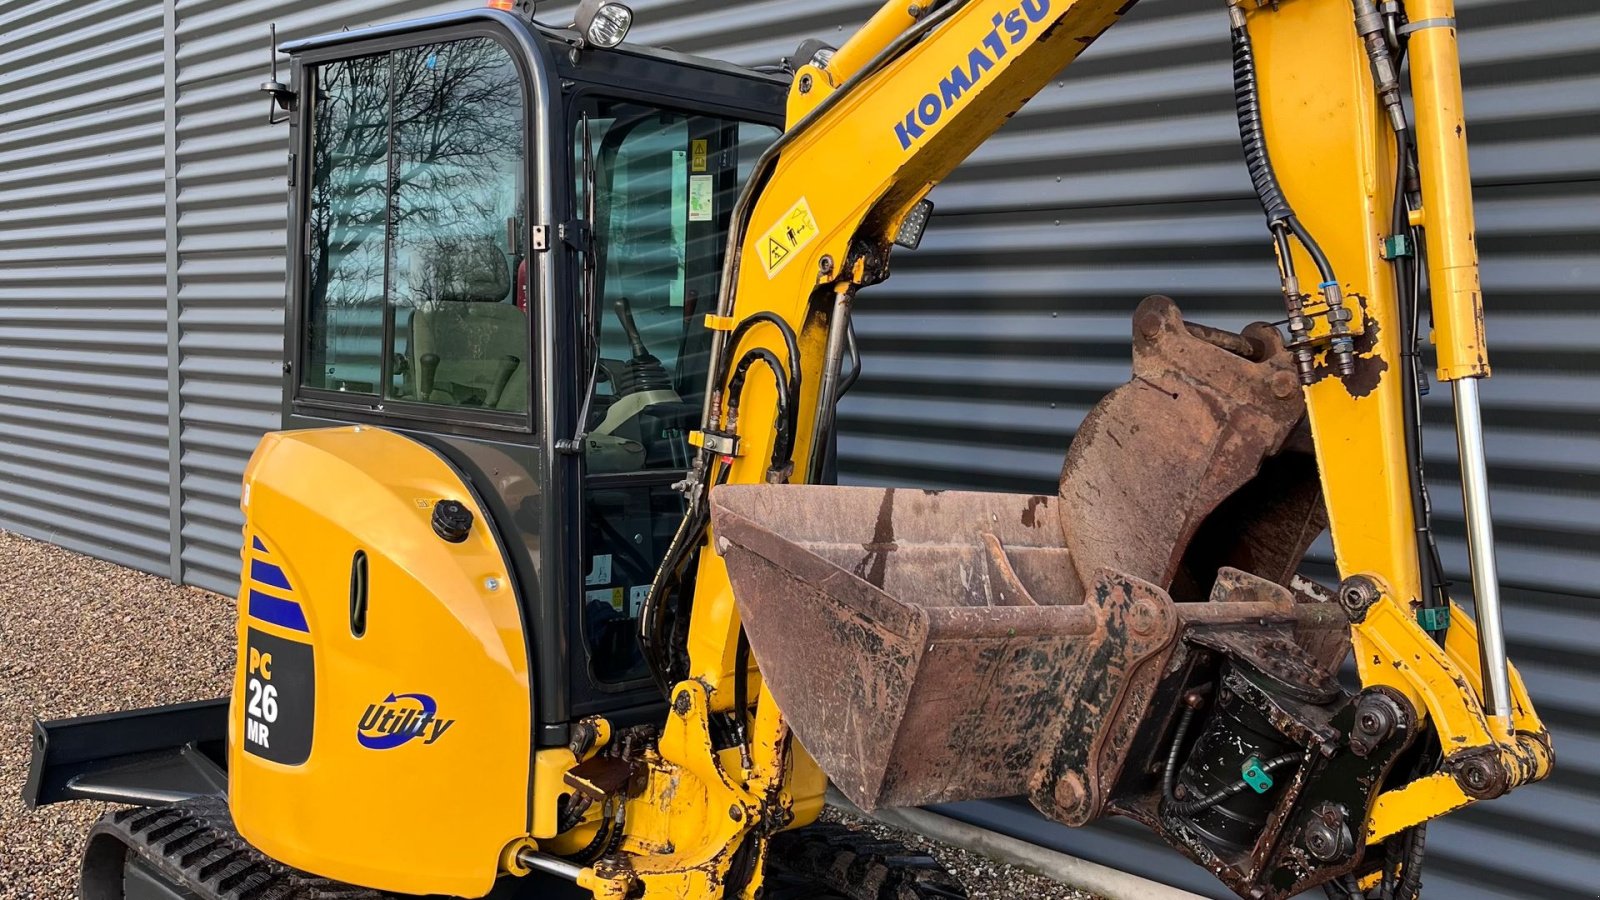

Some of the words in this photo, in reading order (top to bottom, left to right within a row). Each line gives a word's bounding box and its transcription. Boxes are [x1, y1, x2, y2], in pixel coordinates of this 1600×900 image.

[894, 0, 1050, 151] KOMATSU
[249, 646, 272, 680] PC
[248, 678, 278, 723] 26
[247, 717, 270, 749] MR
[358, 704, 455, 744] Utility
